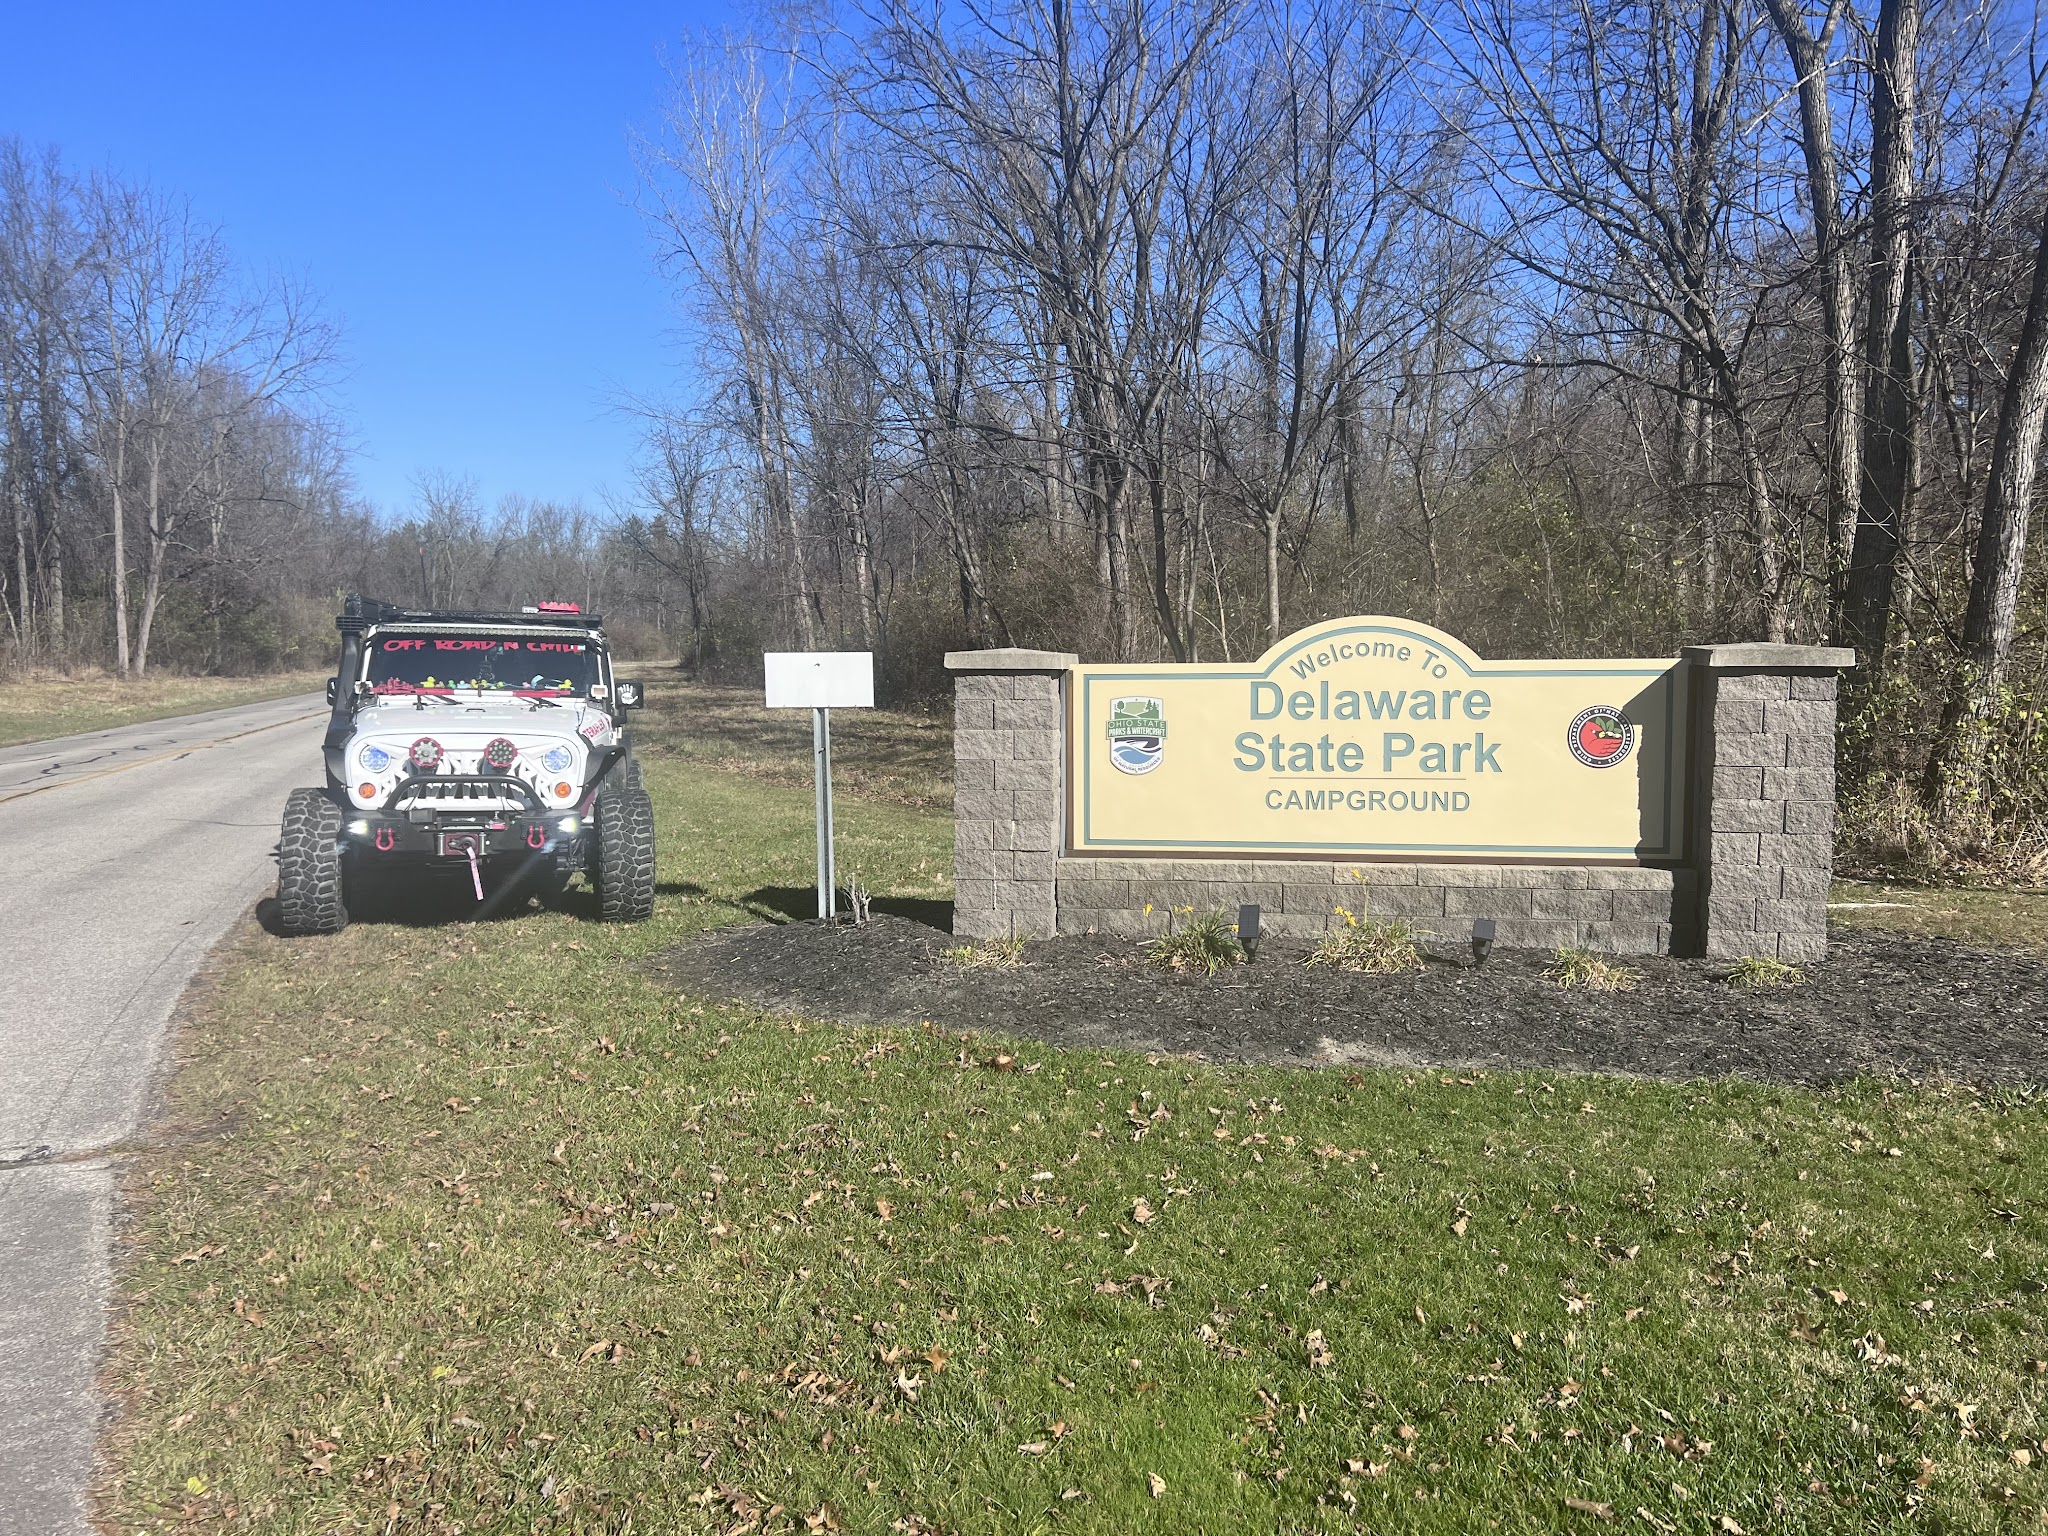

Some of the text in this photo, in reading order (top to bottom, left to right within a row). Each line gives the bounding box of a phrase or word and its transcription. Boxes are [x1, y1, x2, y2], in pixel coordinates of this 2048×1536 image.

[384, 640, 427, 651] OFF
[434, 640, 496, 650] ROAD
[503, 641, 519, 650] N
[1289, 642, 1447, 680] Welcome To
[1250, 681, 1491, 721] Delaware
[1109, 720, 1165, 728] OHIO STATE
[1132, 727, 1165, 736] WATERCRAFT
[1233, 731, 1502, 773] State Park
[1265, 789, 1470, 811] CAMPGROUND
